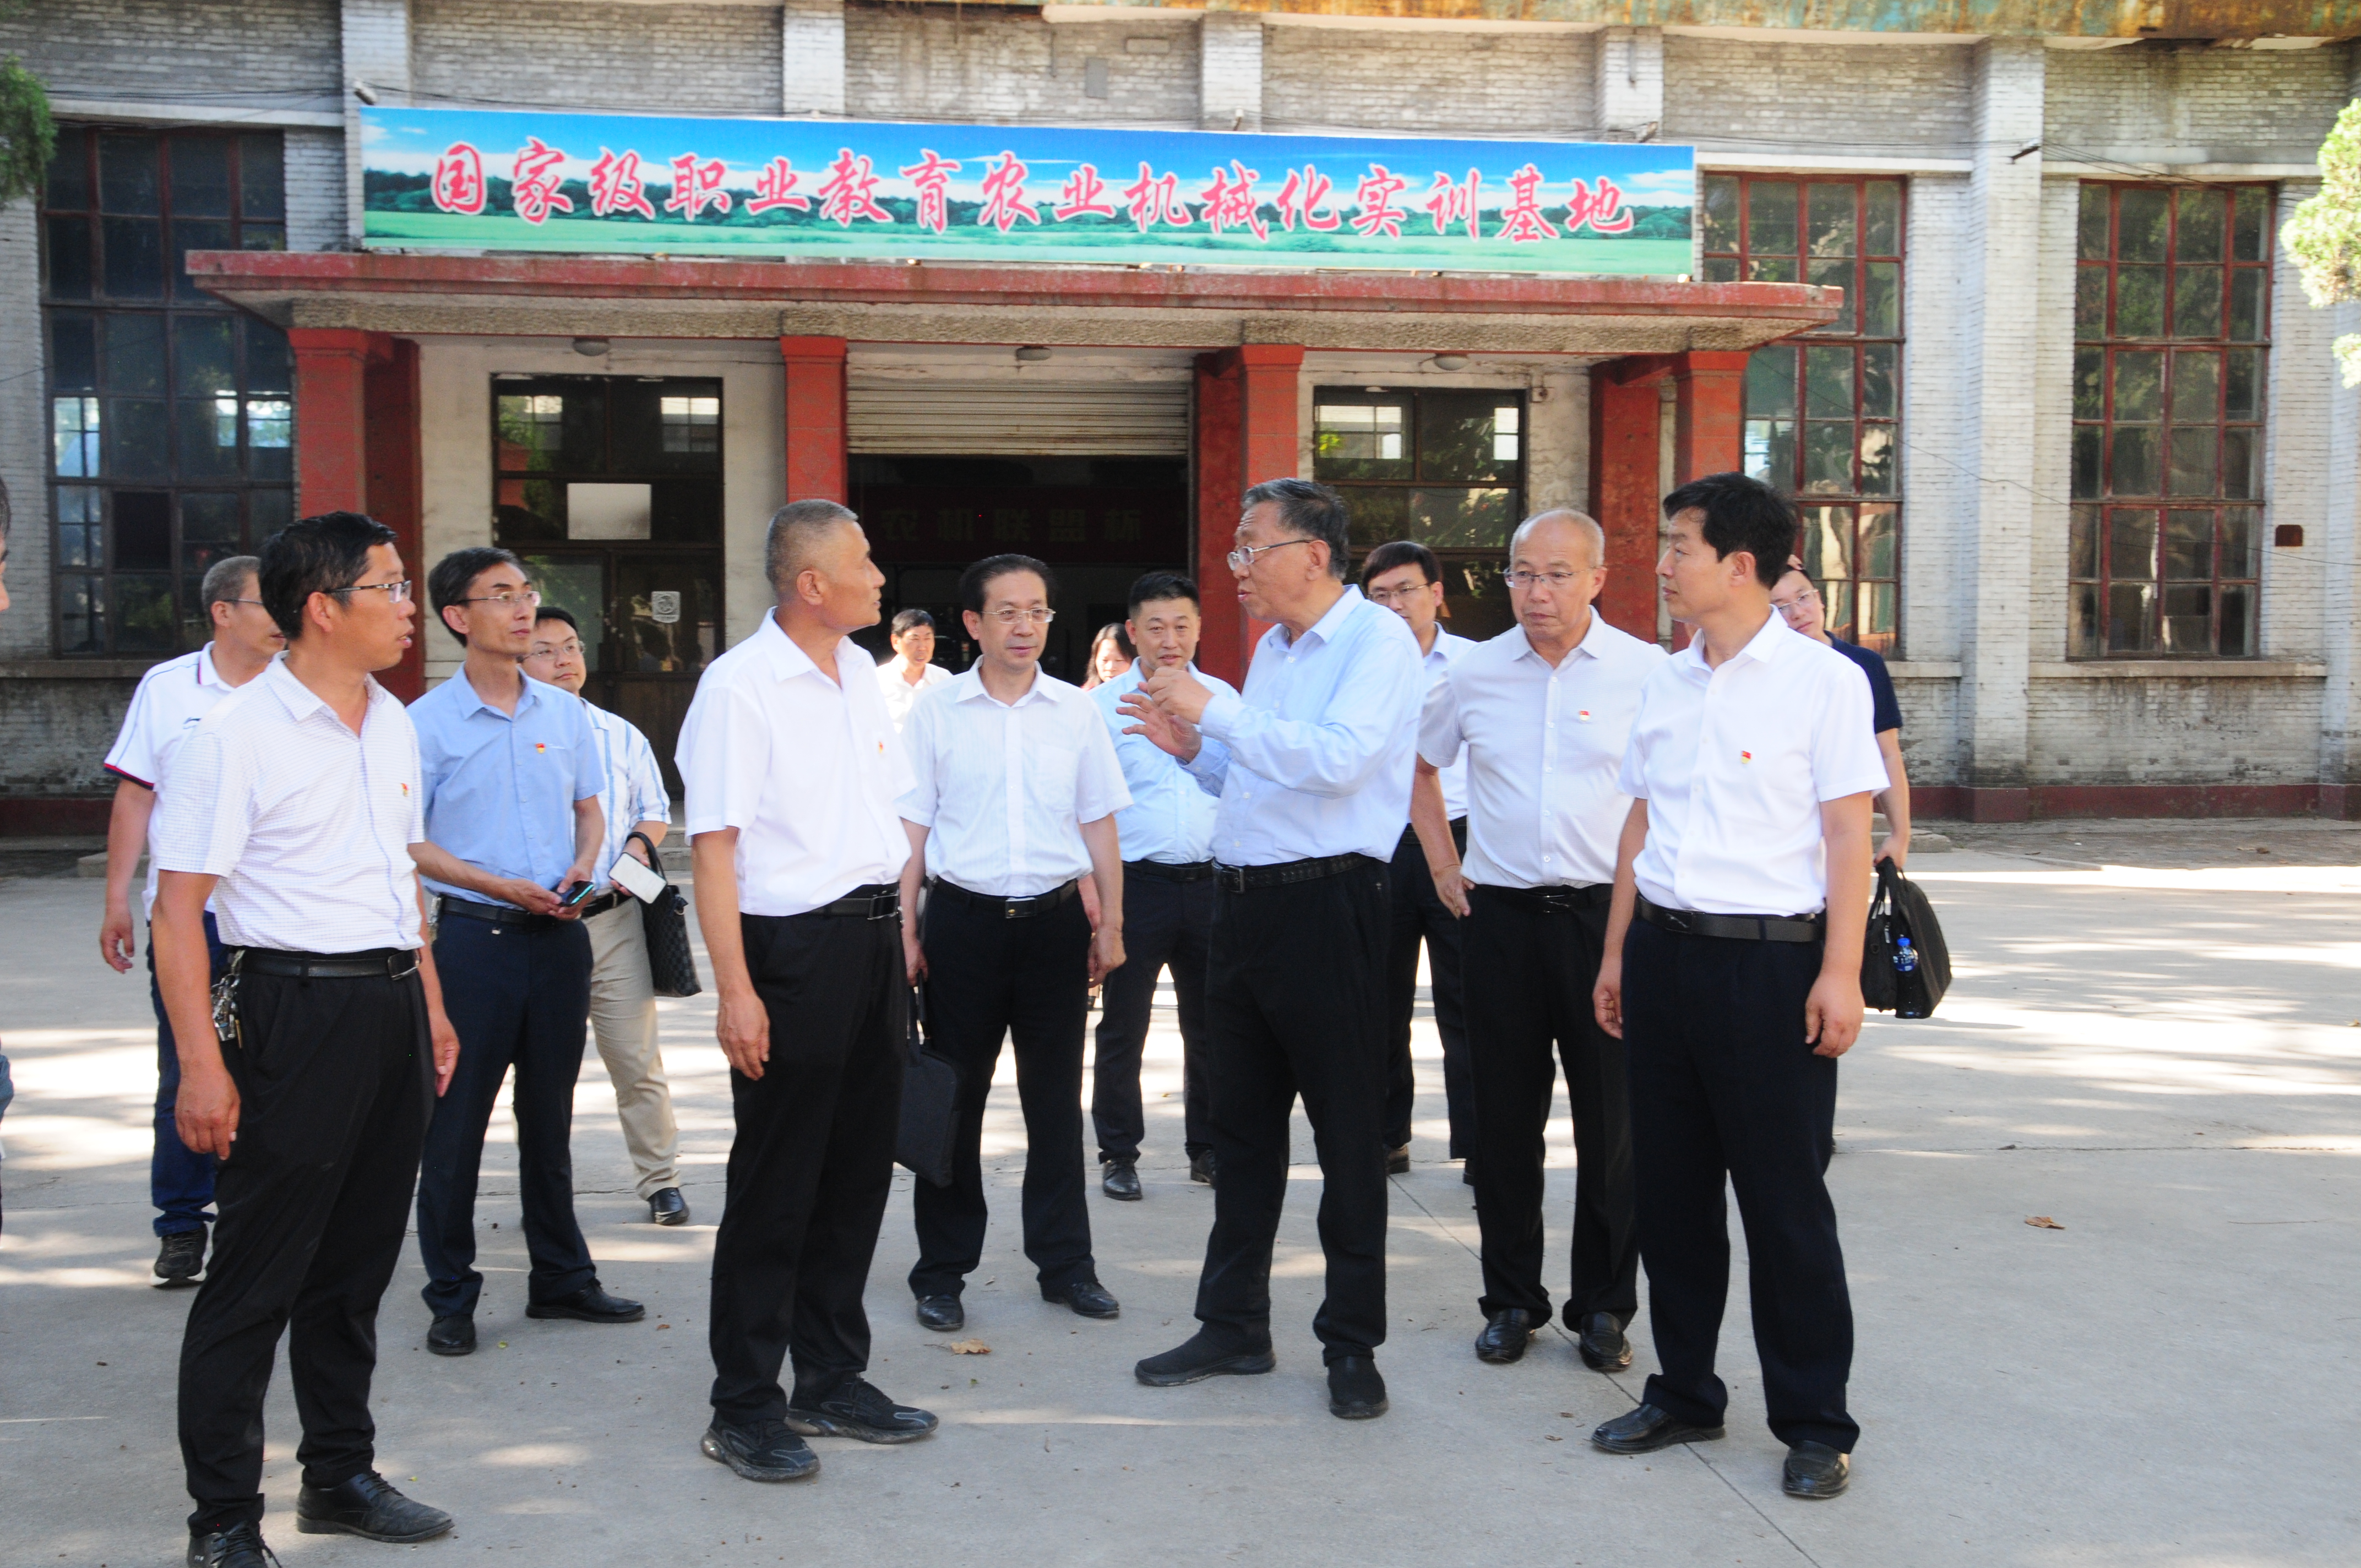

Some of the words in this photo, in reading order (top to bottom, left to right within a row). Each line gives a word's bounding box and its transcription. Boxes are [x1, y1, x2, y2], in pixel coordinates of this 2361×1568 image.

[431, 136, 1634, 243] 国家级职业教育农业机械化实训基地
